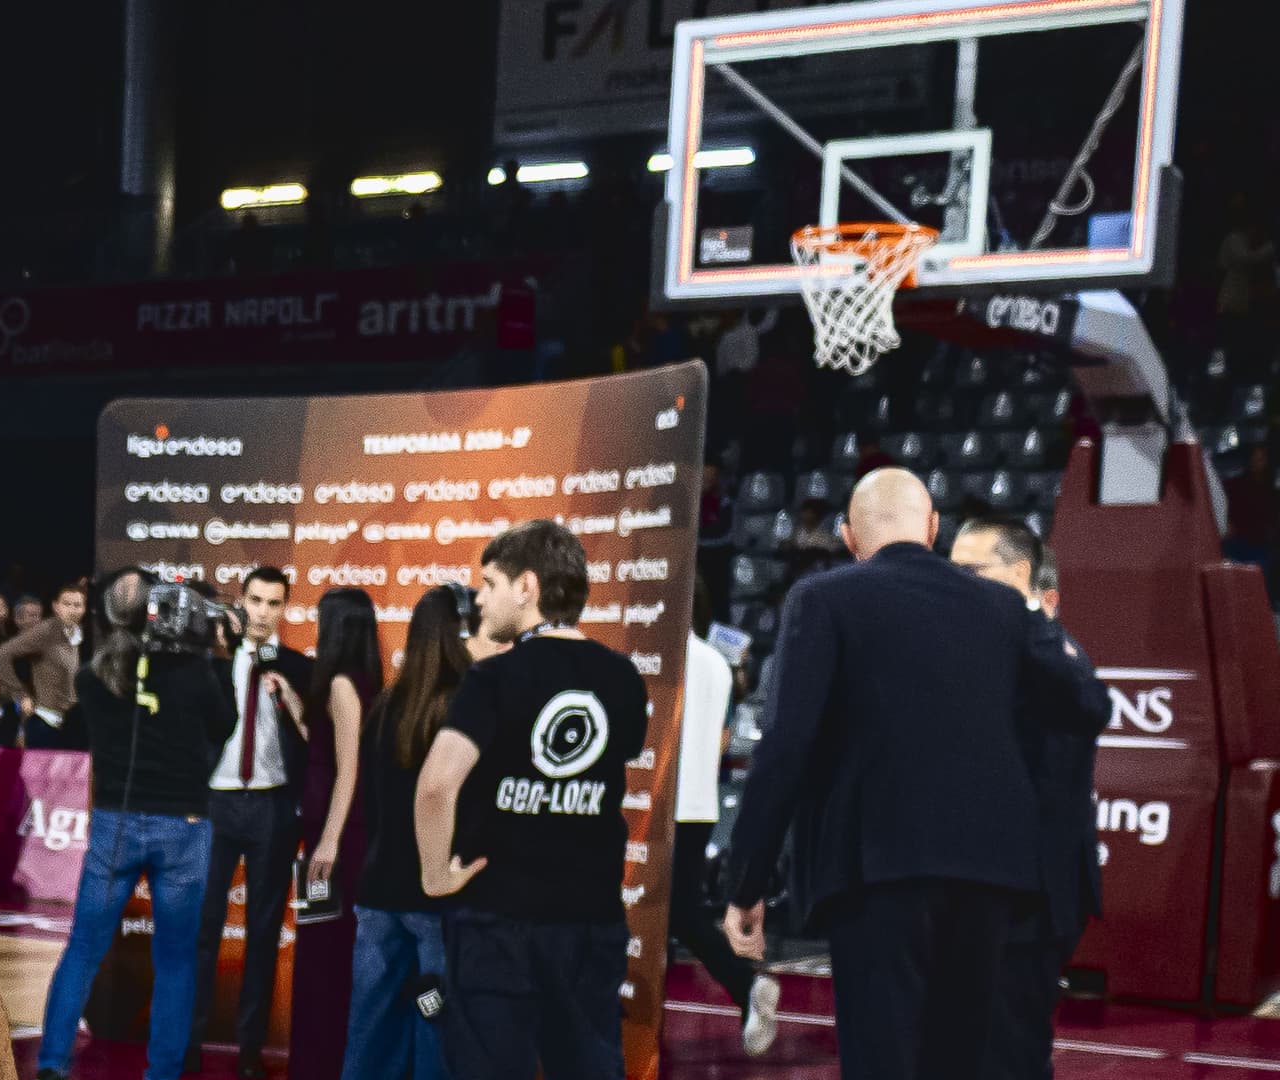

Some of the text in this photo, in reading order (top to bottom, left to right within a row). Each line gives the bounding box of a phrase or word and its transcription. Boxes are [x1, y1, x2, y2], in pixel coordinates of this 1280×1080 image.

[136, 301, 211, 332] PIZZA
[125, 462, 676, 503] endesa endesa endesa endesa endesa endesa endesa
[307, 562, 387, 586] endesa
[397, 562, 471, 586] endesa
